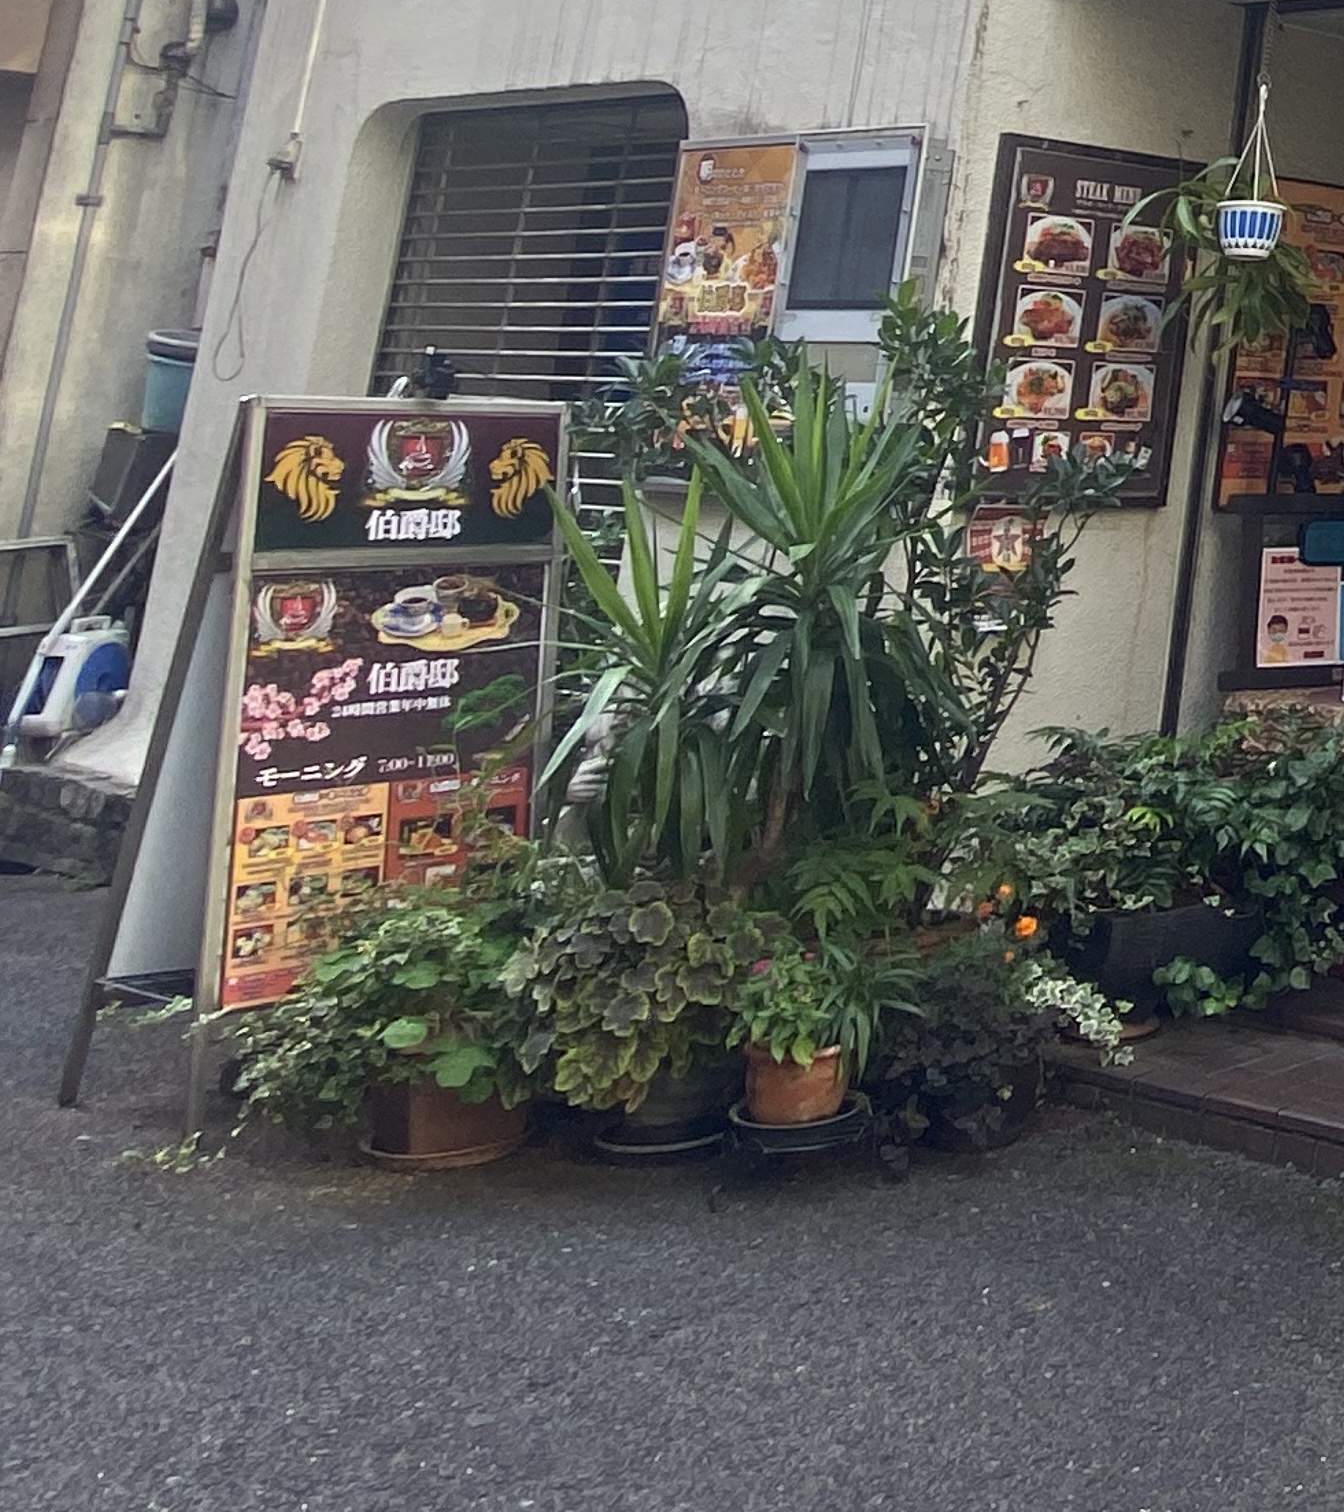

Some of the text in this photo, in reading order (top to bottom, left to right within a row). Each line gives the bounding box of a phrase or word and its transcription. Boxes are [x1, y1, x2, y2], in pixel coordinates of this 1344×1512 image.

[365, 507, 462, 542] 伯爵邸
[366, 657, 461, 695] 伯爵邸
[254, 755, 368, 788] モーニング
